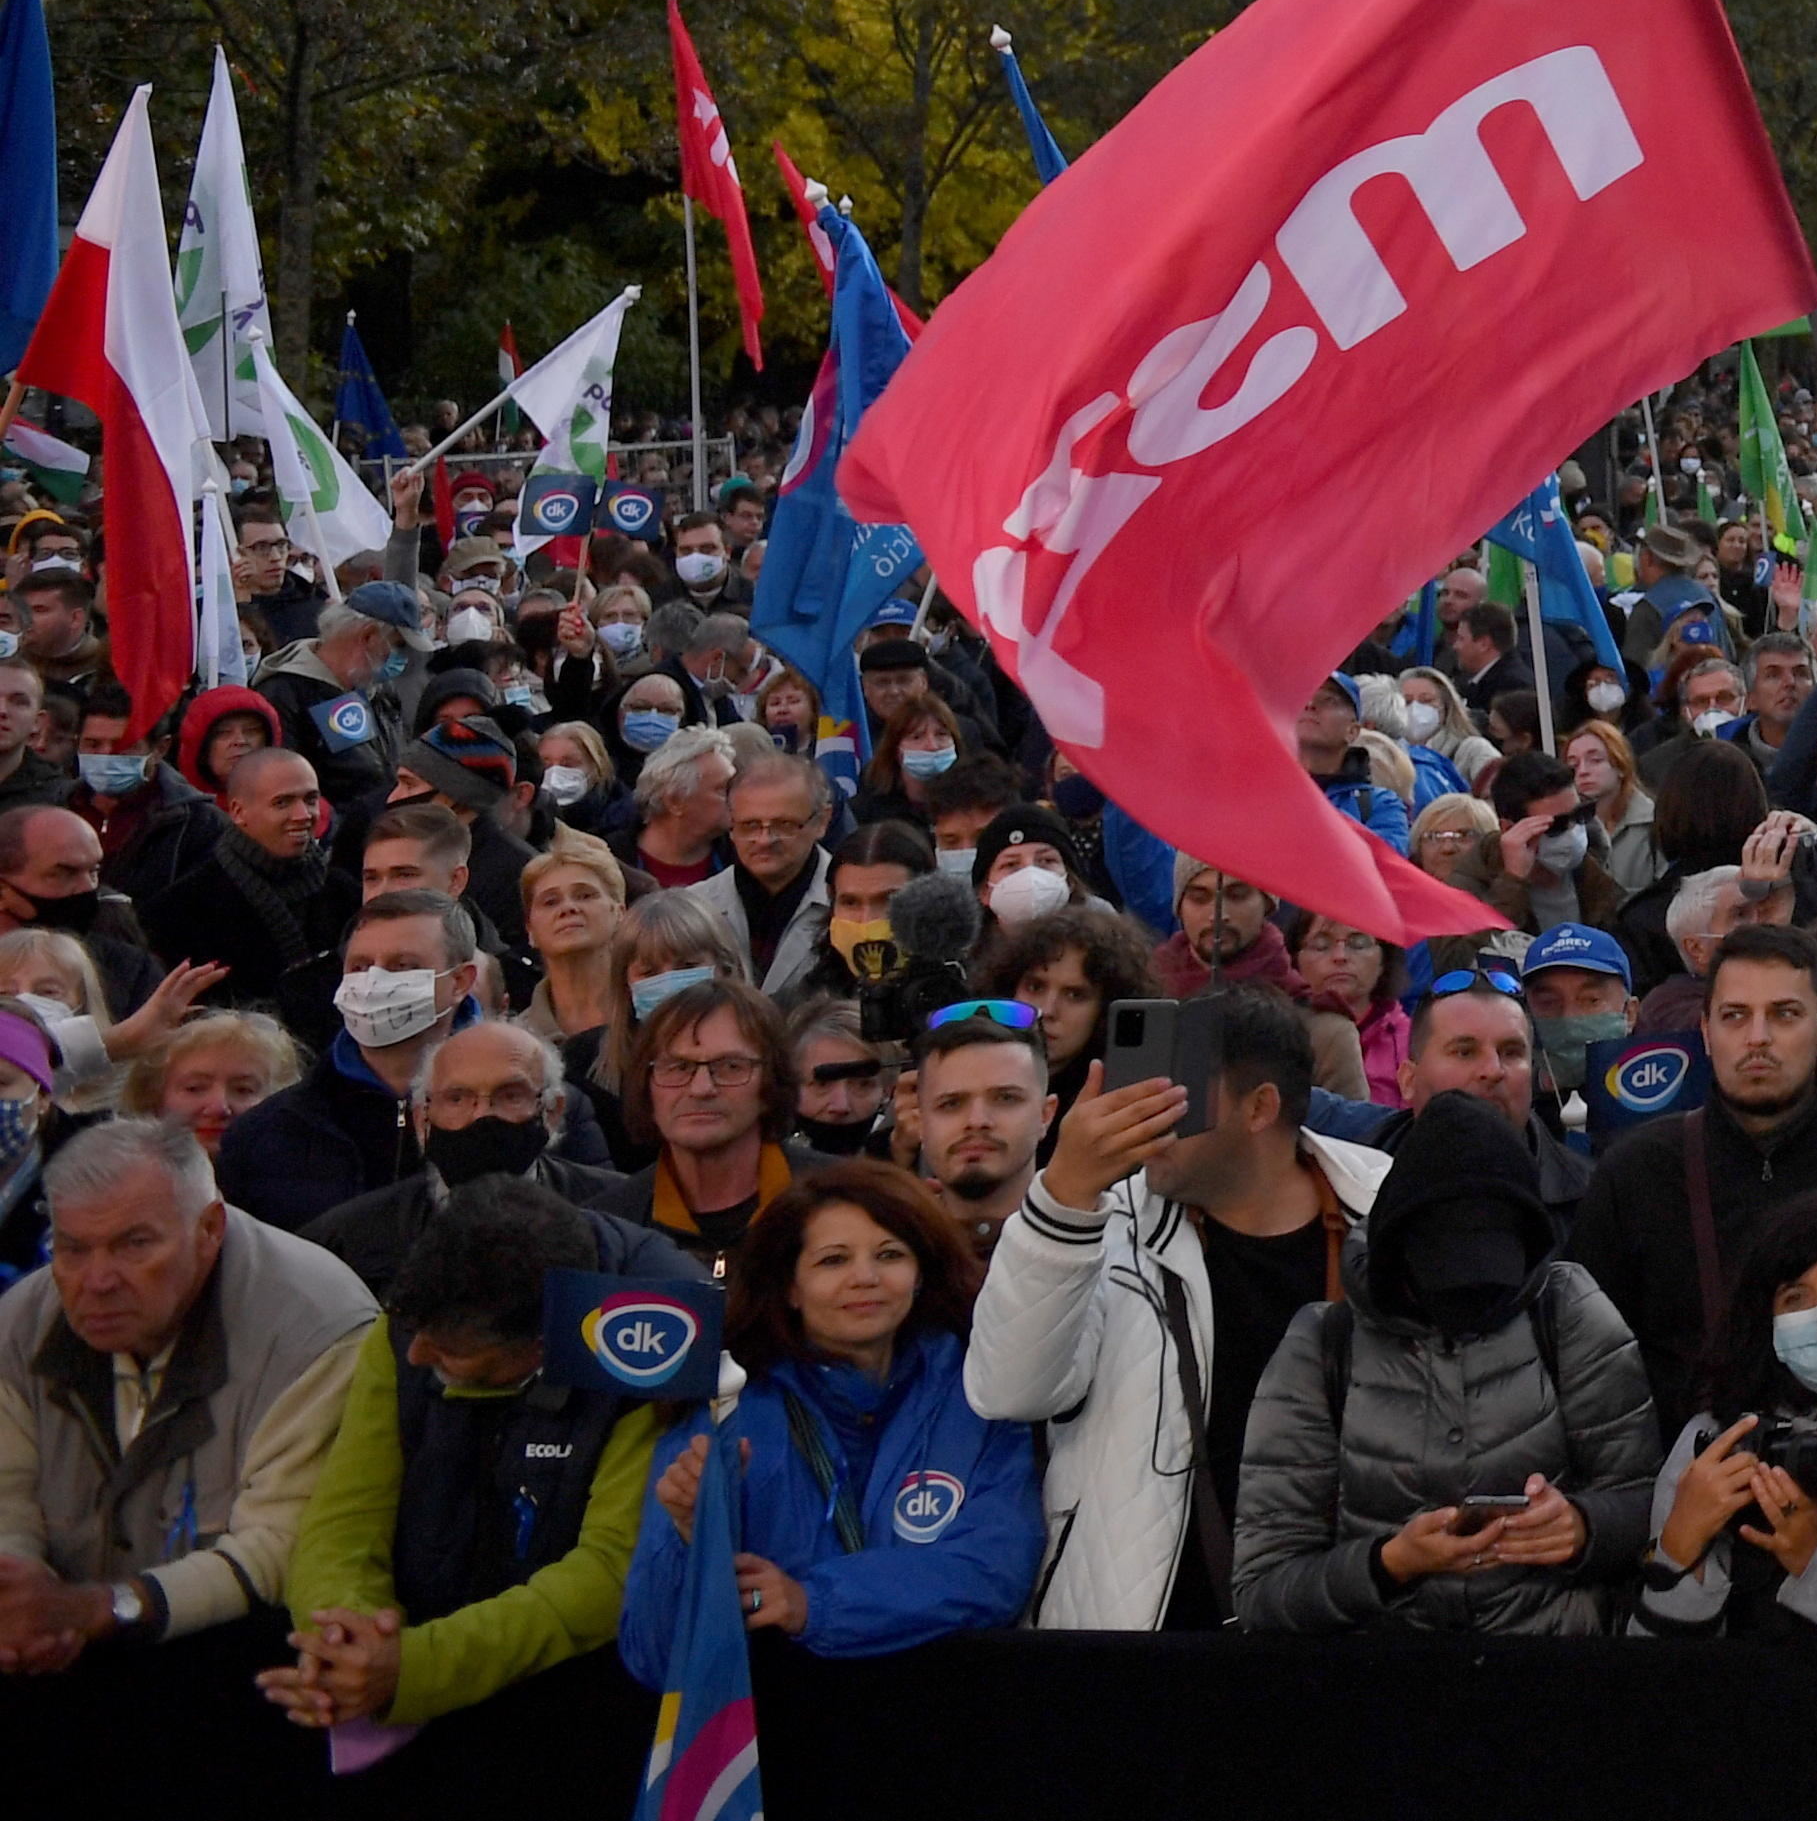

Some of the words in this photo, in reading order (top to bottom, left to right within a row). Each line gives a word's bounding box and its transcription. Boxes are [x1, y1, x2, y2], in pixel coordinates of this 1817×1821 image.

[545, 501, 567, 518] dk
[620, 502, 642, 520] dk
[1631, 1062, 1668, 1088] dk
[616, 1321, 665, 1355] dk
[906, 1491, 941, 1518] dk
